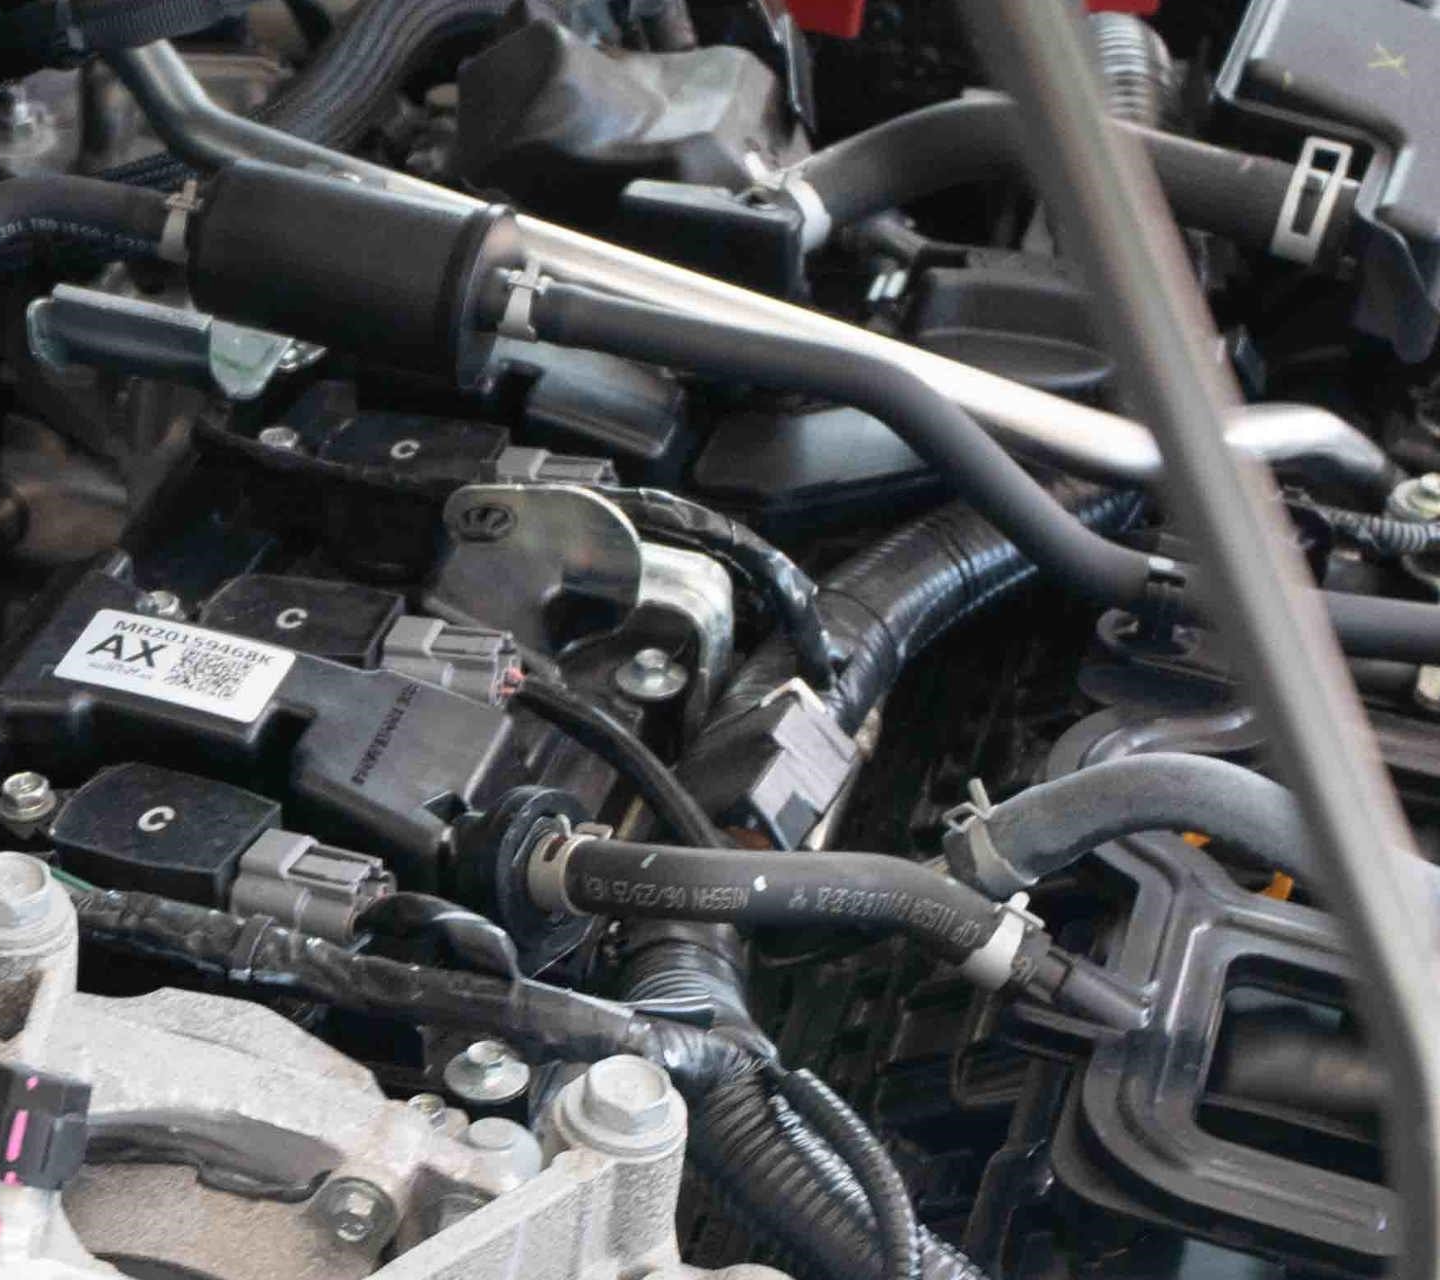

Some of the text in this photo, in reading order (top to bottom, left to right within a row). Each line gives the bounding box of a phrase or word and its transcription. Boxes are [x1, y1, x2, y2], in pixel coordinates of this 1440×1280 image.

[389, 439, 421, 460] C
[275, 607, 308, 630] C
[86, 633, 168, 668] AX
[112, 619, 277, 666] MR20159468K
[136, 804, 177, 833] C
[691, 886, 751, 912] NISSAN
